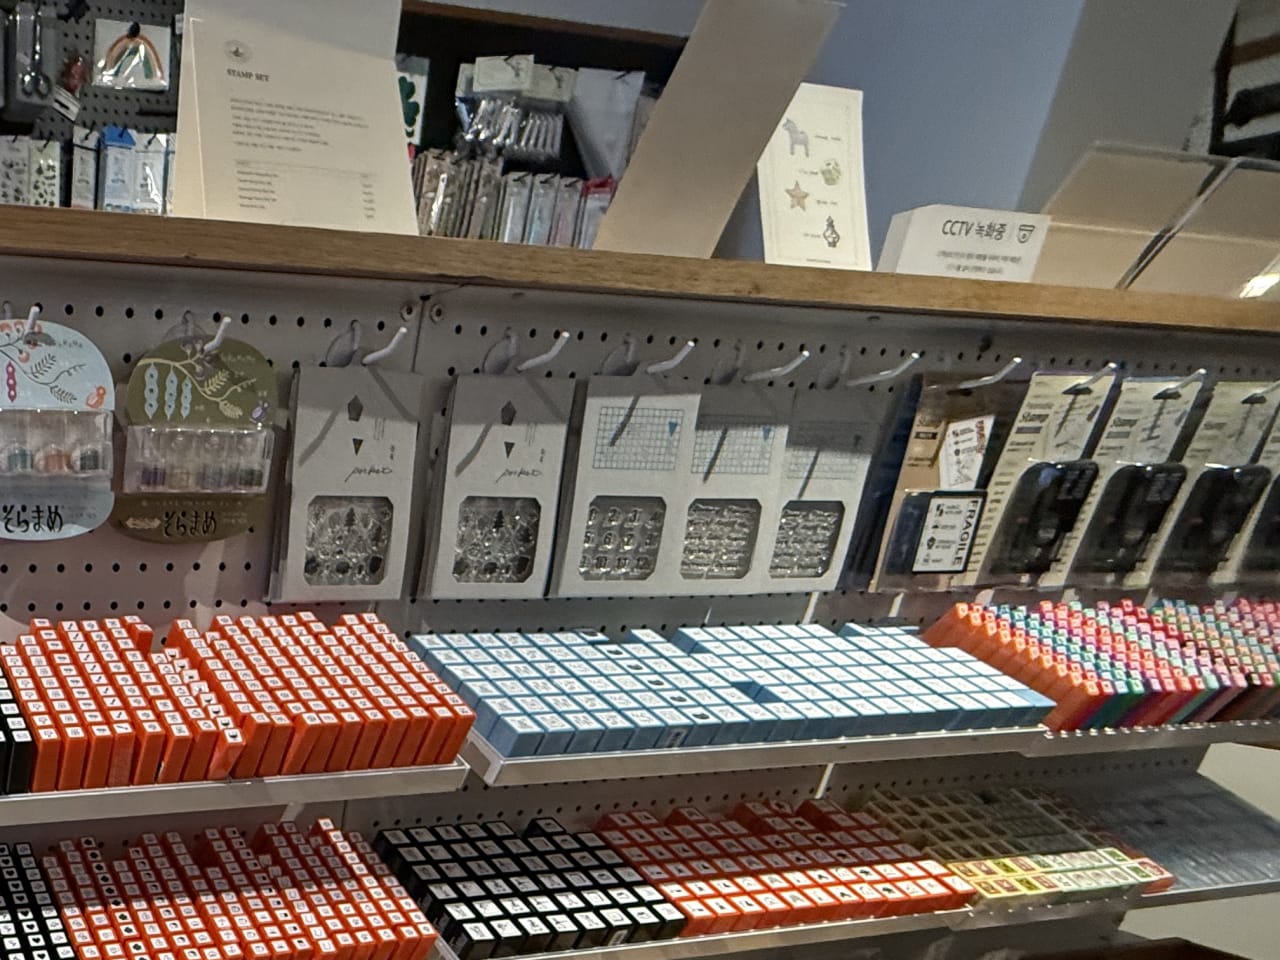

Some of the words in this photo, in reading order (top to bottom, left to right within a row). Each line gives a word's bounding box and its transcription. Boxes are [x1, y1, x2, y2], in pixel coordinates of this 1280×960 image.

[226, 68, 253, 81] STAMP
[255, 72, 270, 82] SET
[942, 219, 974, 237] CCTV
[975, 221, 1007, 241] 녹화중
[1, 503, 65, 535] そらまめ
[162, 510, 218, 538] そらまめ
[952, 500, 979, 567] FRAGILE
